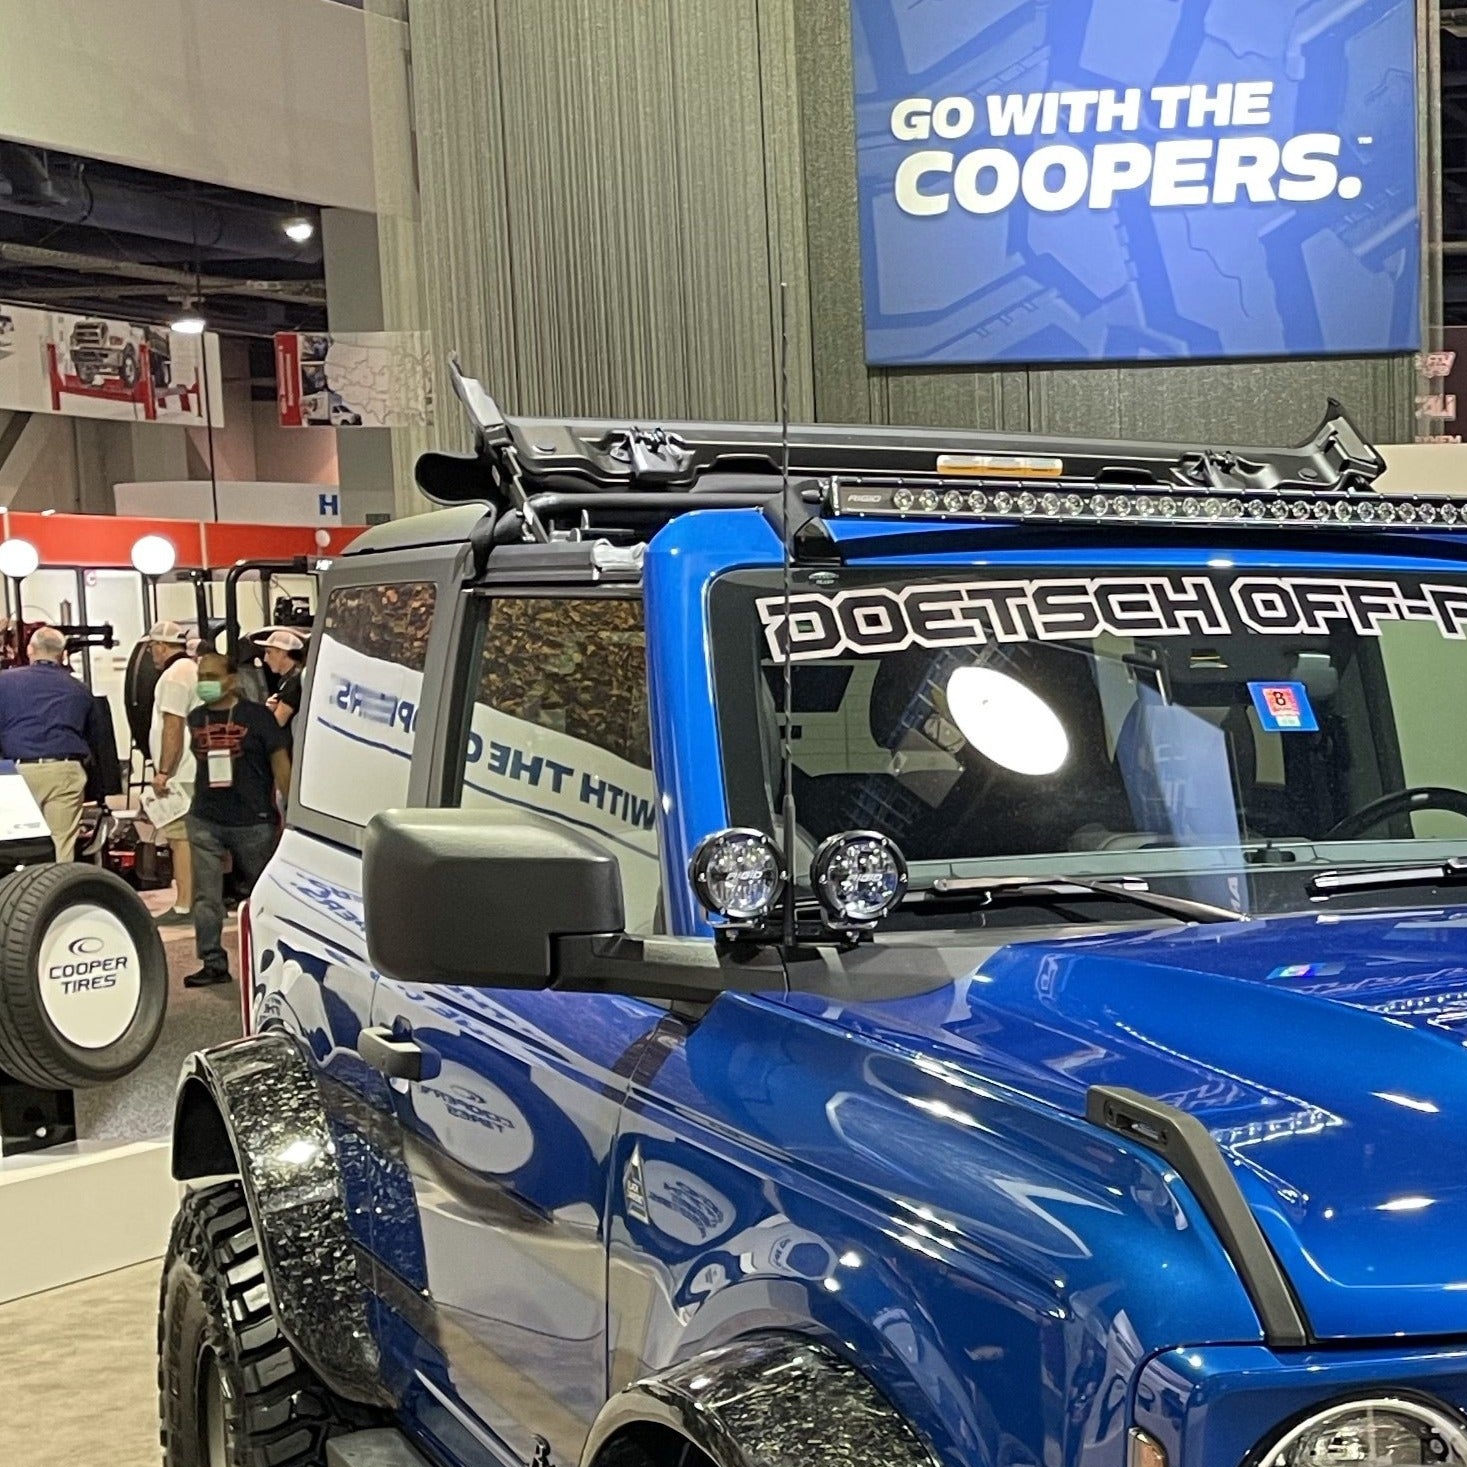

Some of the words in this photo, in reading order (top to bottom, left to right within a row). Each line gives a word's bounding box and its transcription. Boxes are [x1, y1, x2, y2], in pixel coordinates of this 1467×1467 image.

[891, 96, 975, 141] GO
[986, 87, 1141, 137] WITH
[1150, 81, 1274, 129] THE
[894, 133, 1363, 216] COOPERS.
[319, 494, 338, 516] H
[756, 577, 1232, 662] DOETSCH
[1273, 691, 1286, 706] 8
[49, 957, 127, 979] COOPER
[62, 974, 116, 994] TIRES
